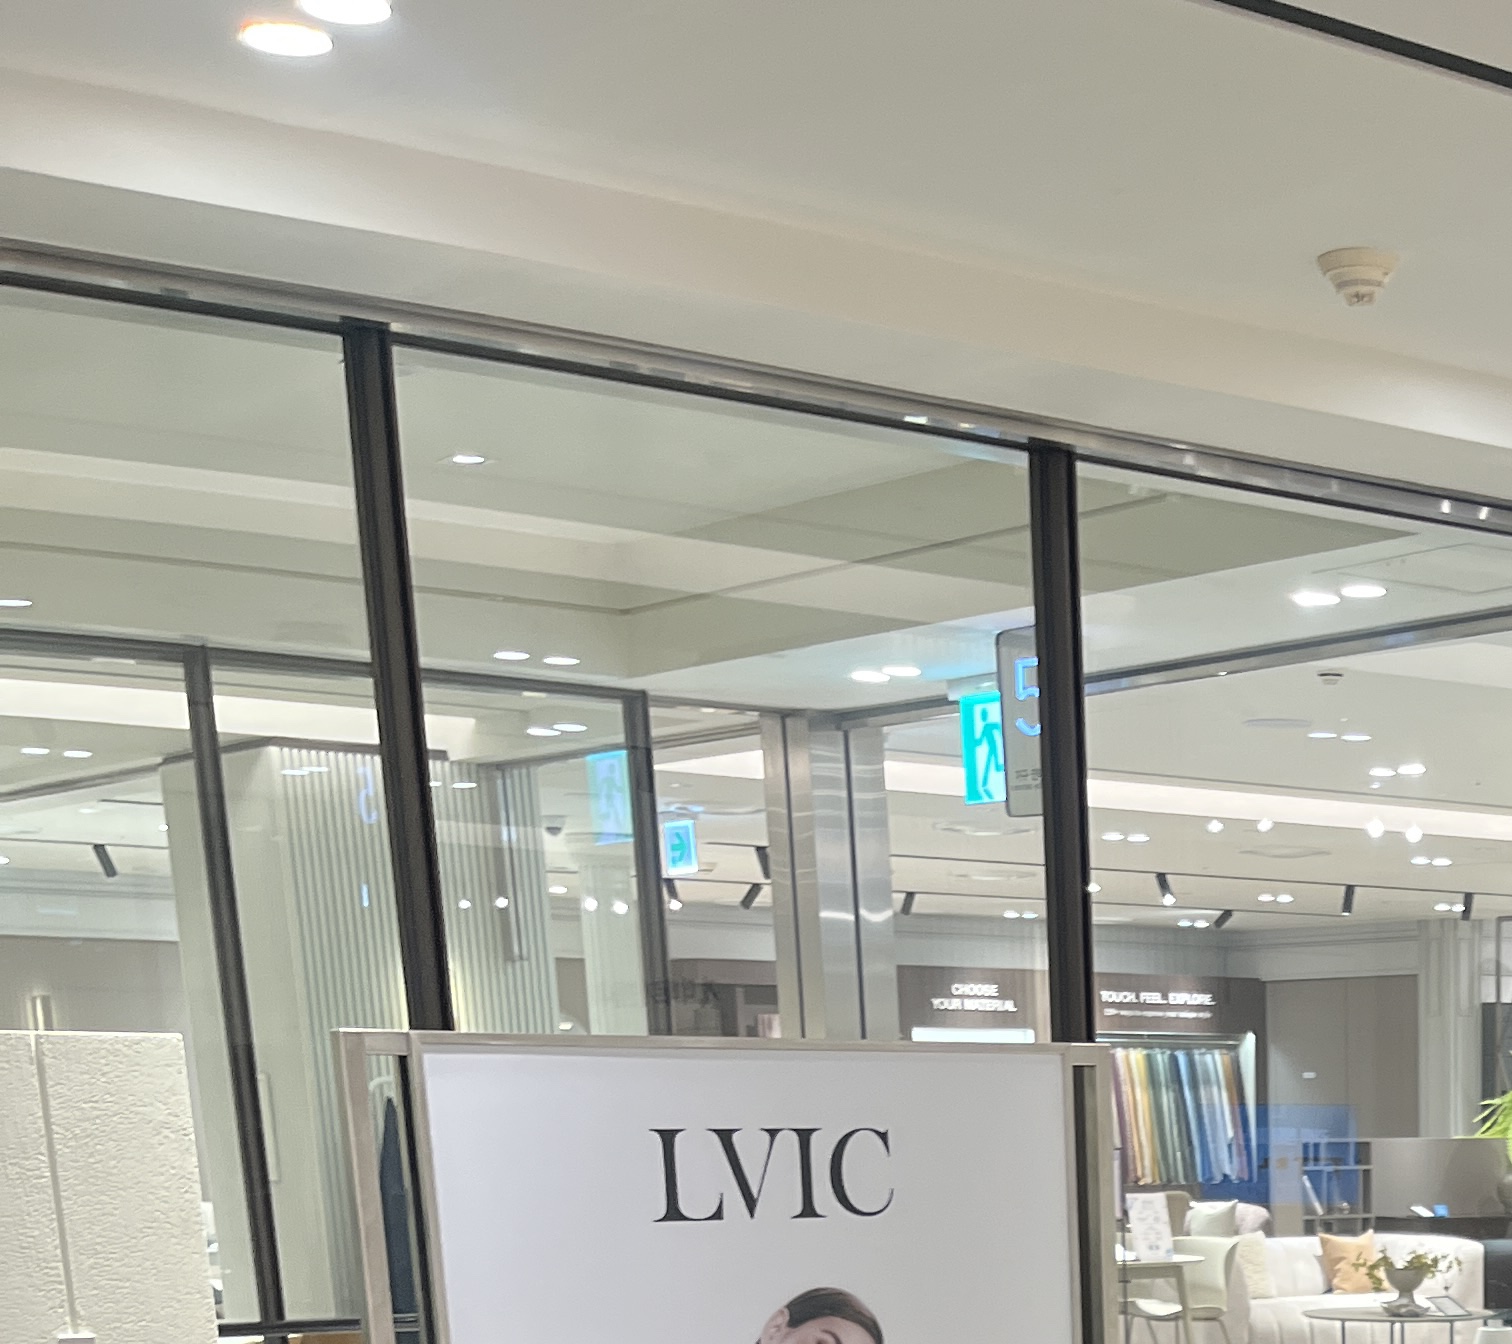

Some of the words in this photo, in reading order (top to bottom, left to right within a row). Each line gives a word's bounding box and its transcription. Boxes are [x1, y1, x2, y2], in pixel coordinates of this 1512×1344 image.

[950, 983, 999, 997] CHOOSE
[931, 998, 962, 1011] YOUR
[963, 998, 1018, 1012] MATERIAL
[648, 1127, 894, 1223] LVIC
